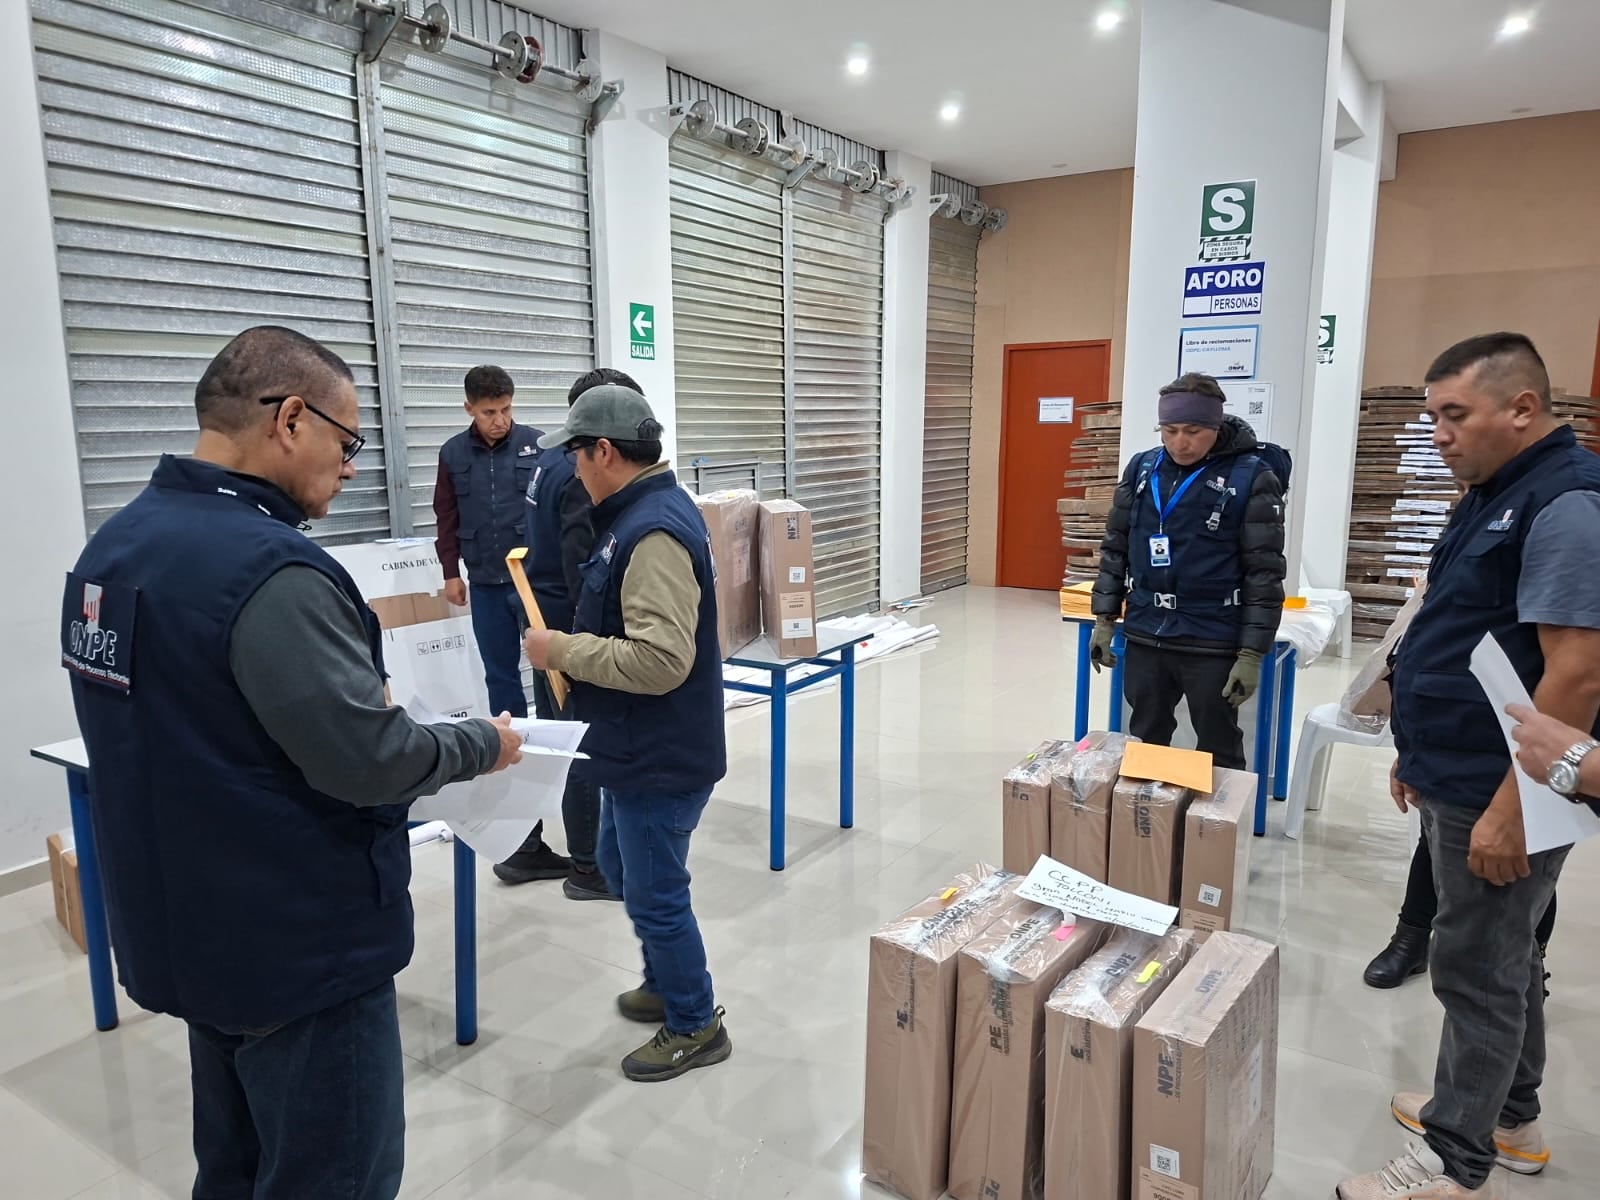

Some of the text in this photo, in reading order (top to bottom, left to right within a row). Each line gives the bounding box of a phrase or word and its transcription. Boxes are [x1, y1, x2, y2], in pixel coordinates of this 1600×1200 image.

[1208, 187, 1246, 232] S
[1186, 268, 1262, 291] AFORO
[1213, 296, 1258, 310] PERSONAS
[631, 345, 654, 358] SALIDA
[381, 560, 415, 571] CABINA
[416, 558, 428, 567] DE
[71, 620, 117, 667] ONPE
[1010, 918, 1041, 940] ONPE
